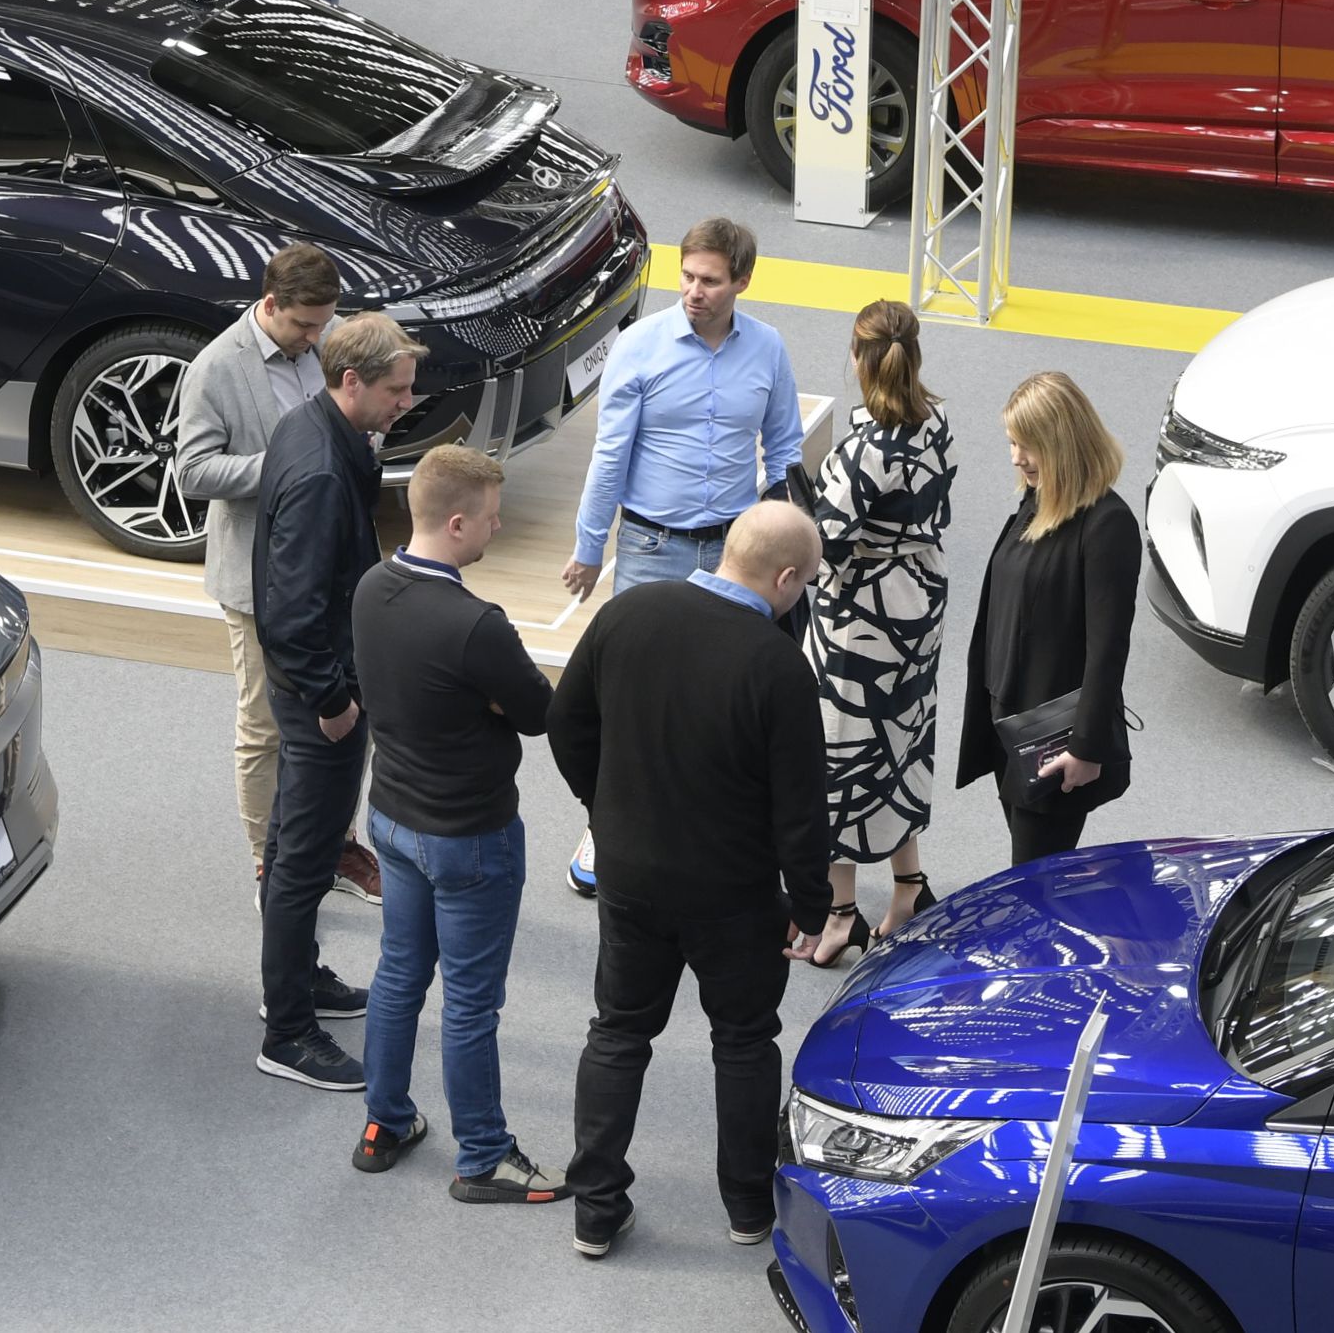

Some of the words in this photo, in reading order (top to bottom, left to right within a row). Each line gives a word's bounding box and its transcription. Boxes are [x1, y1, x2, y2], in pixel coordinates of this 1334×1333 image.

[809, 21, 857, 135] Ford
[582, 346, 605, 376] IONIQ
[601, 340, 609, 357] 6
